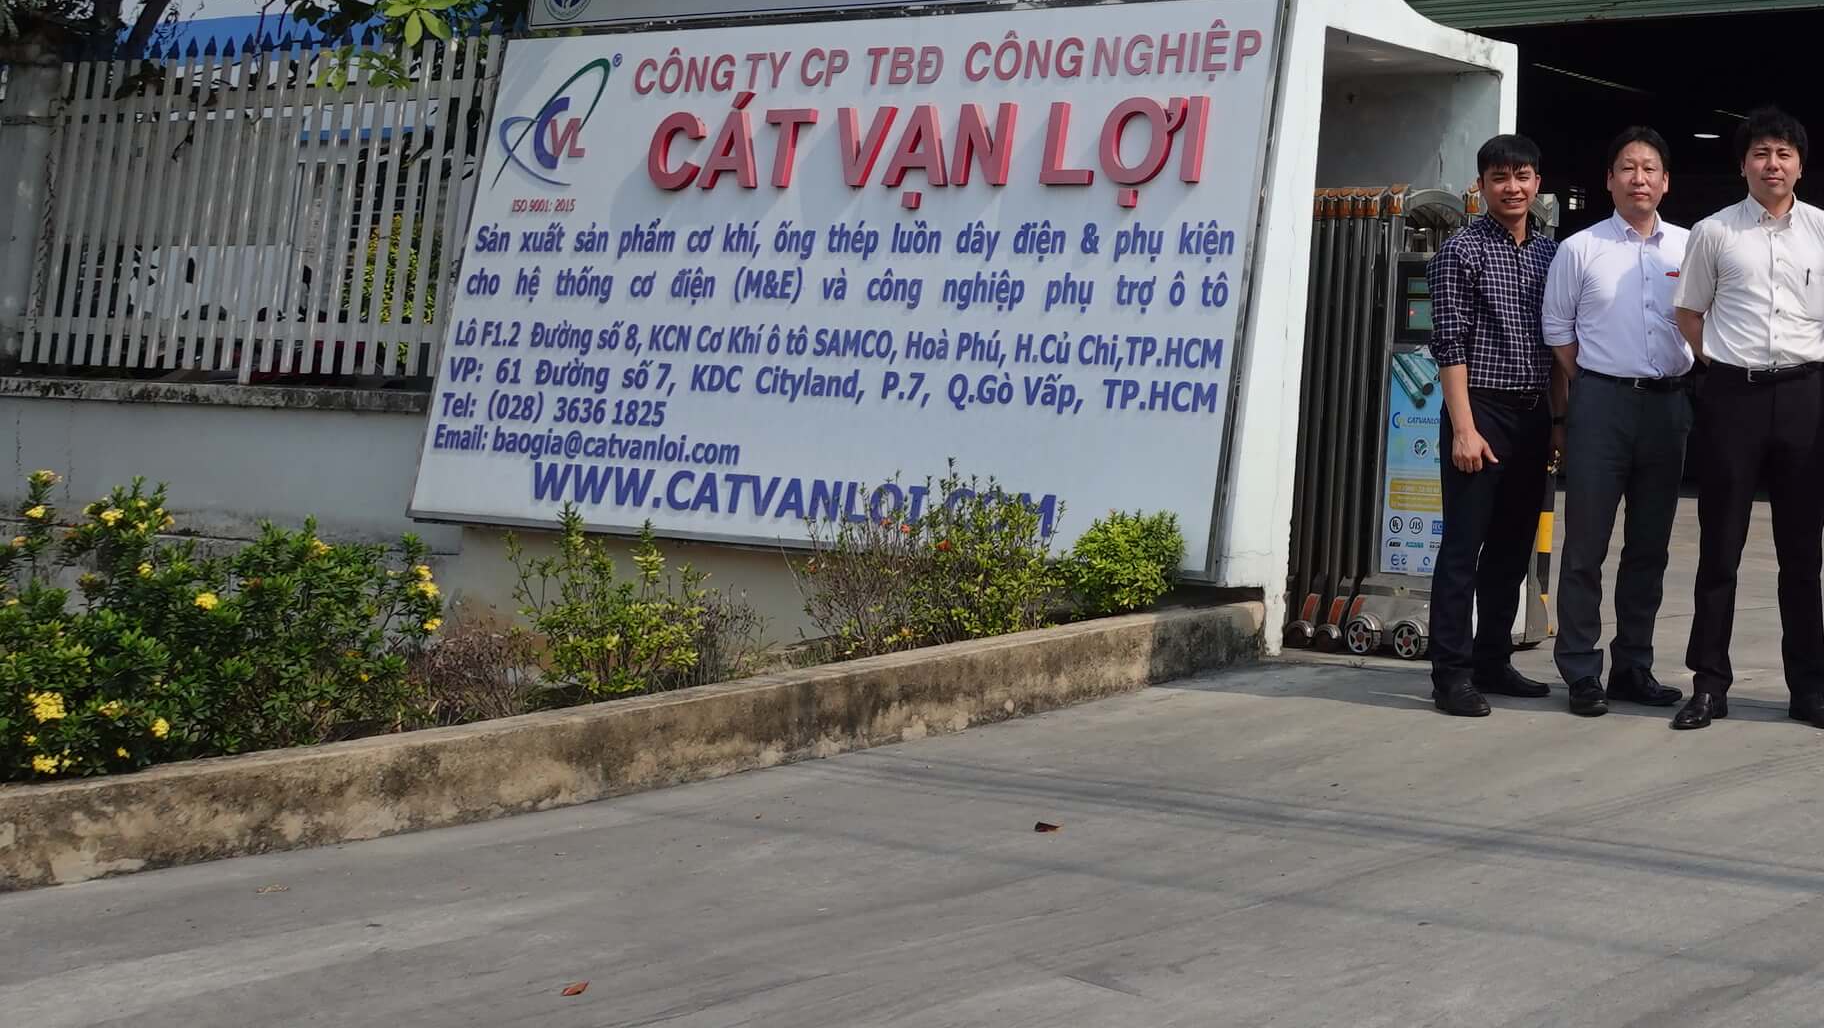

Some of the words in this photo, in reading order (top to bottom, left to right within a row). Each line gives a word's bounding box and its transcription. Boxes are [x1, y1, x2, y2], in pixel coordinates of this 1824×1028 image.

[634, 47, 737, 94] CÔNG
[746, 50, 791, 92] TY
[800, 47, 849, 87] CP
[867, 45, 944, 85] TBĐ
[964, 30, 1085, 82] CÔNG
[1092, 19, 1263, 82] NGHIỆP
[648, 91, 820, 191] CÁT
[838, 102, 1018, 210] VẠN
[1039, 95, 1210, 208] LỢI
[475, 225, 510, 253] Sản
[519, 221, 565, 253] xuất
[574, 222, 608, 253] sản
[617, 218, 675, 259] phẩm
[687, 228, 713, 253] cơ
[722, 220, 760, 258] khí,
[774, 221, 816, 260] ống
[828, 220, 879, 262] thép
[891, 220, 941, 255] luồn
[956, 221, 999, 262] dây
[1013, 221, 1066, 263] điện
[1080, 222, 1100, 255] &
[1114, 222, 1163, 263] phụ
[1178, 221, 1234, 264] kiện
[455, 321, 478, 346] Lô
[481, 321, 520, 348] F1.2
[530, 322, 593, 357] Đường
[597, 320, 624, 351] số
[624, 328, 641, 357] 8,
[649, 324, 692, 353] KCN
[699, 326, 723, 354] Cơ
[727, 324, 765, 355] Khí
[767, 326, 780, 356] ô
[786, 326, 808, 356] tô
[813, 327, 897, 365] SAMCO,
[905, 329, 948, 360] Hoà
[956, 330, 1007, 369] Phú,
[1014, 331, 1070, 365] H.Củ
[442, 392, 476, 418] Tel:
[487, 389, 544, 422] (028)
[553, 397, 606, 423] 3636
[611, 399, 667, 427] 1825
[433, 424, 488, 451] Email:
[492, 425, 740, 466] baogia@catvanloi.com
